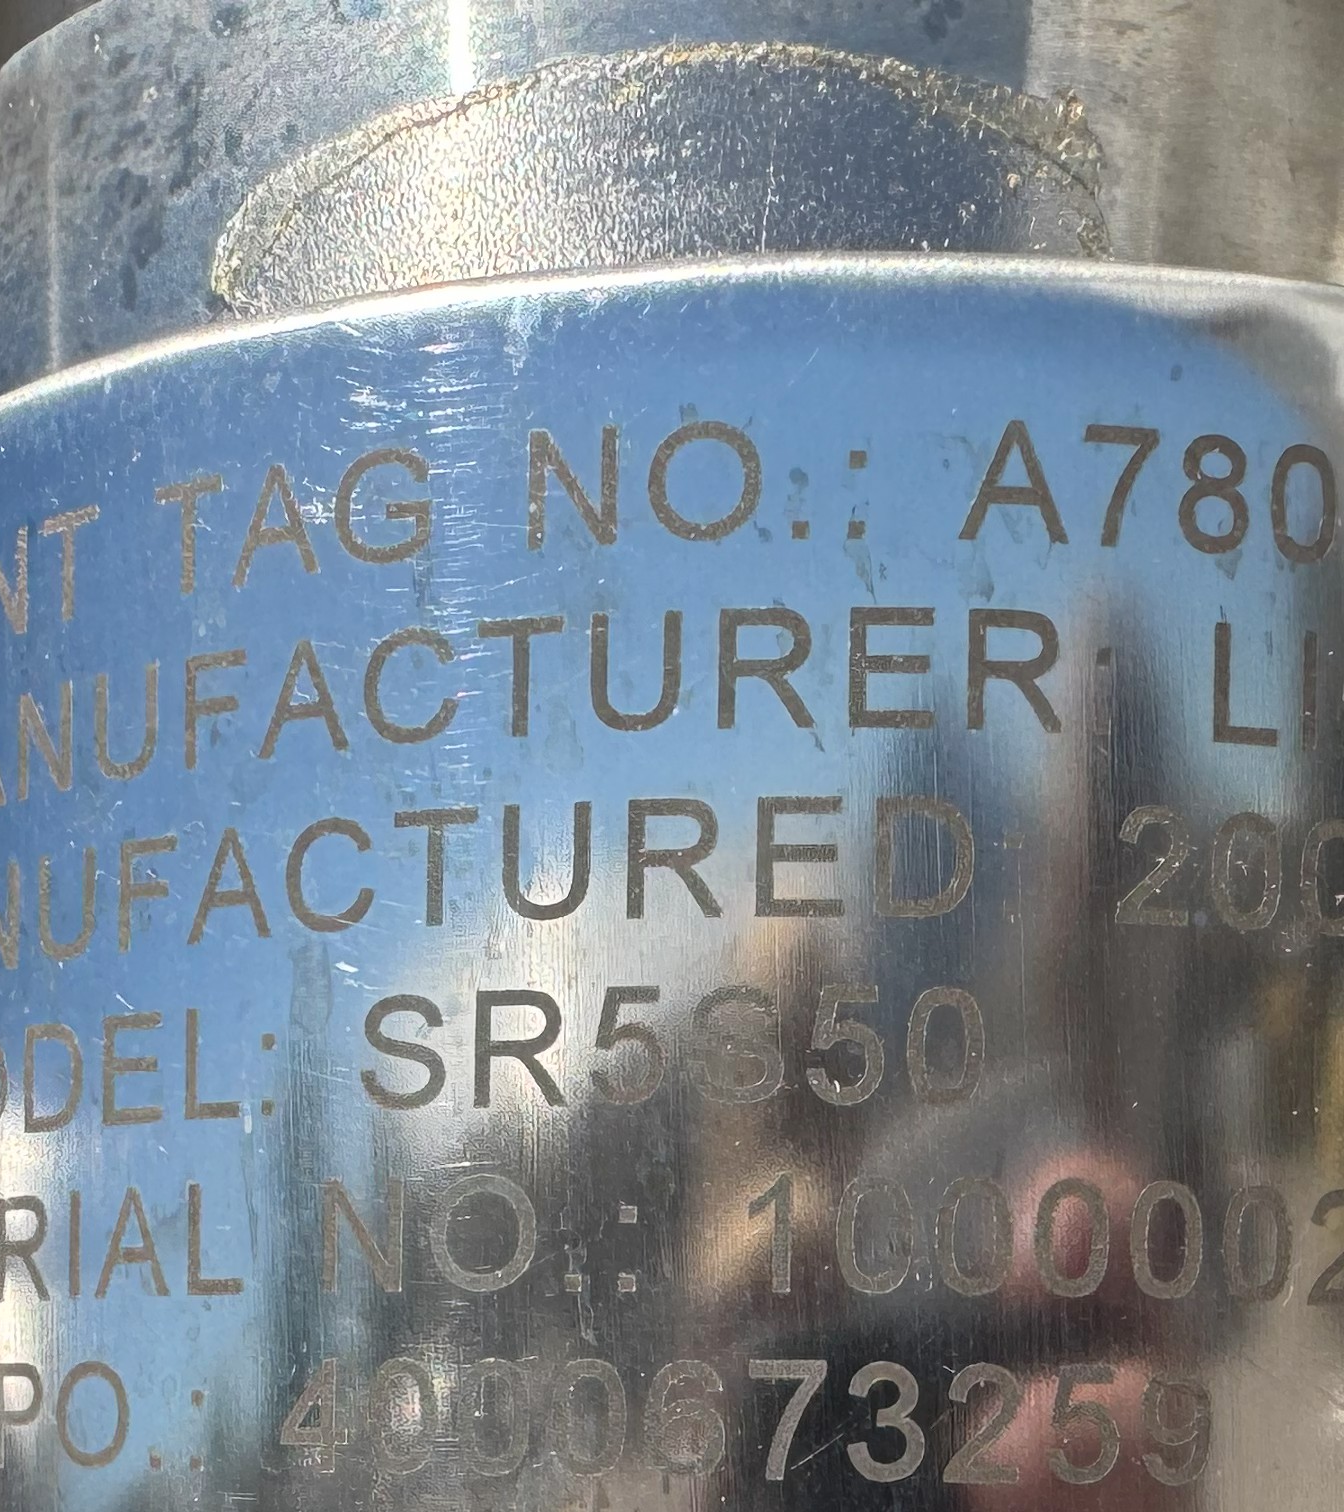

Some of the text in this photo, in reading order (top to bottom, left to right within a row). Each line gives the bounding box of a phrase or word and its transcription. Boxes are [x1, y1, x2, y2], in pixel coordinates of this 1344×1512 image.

[155, 447, 433, 593] TAG
[527, 419, 868, 550] NO.:
[321, 1172, 637, 1295] NO.:
[279, 1357, 1212, 1487] 4000673259
